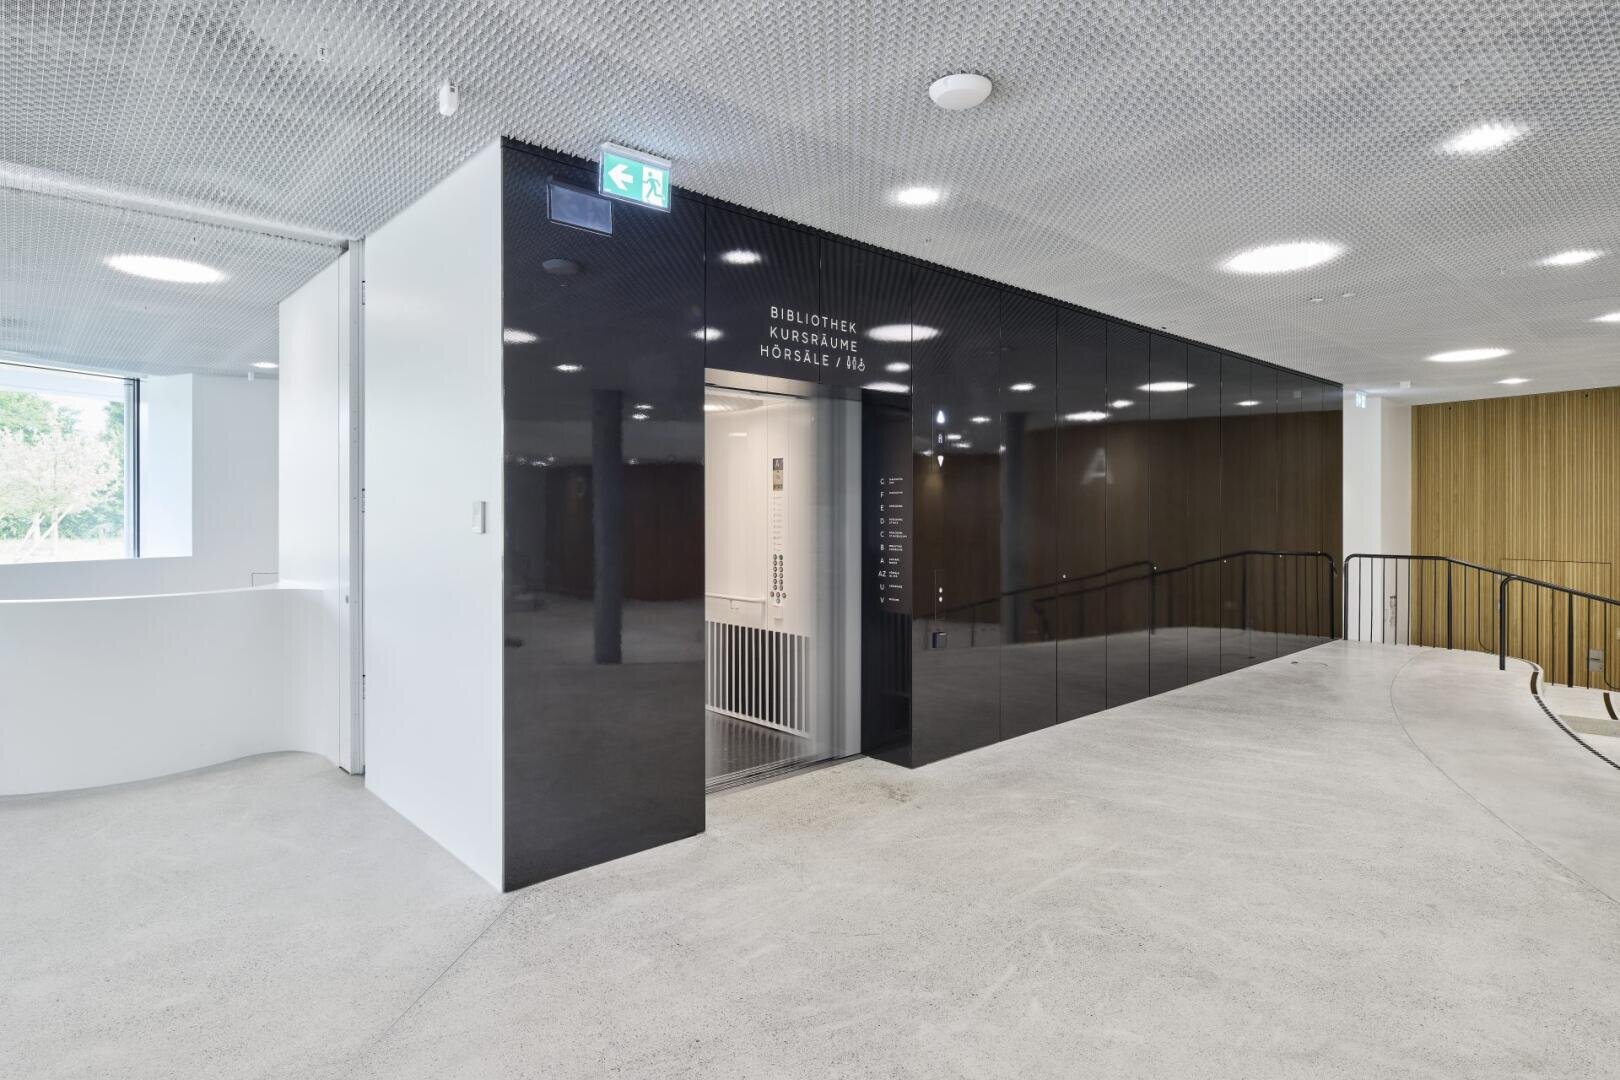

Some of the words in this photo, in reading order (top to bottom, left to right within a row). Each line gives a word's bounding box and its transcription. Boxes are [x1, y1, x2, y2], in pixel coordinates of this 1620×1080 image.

[770, 306, 857, 334] BIBLIOTHEK
[769, 326, 858, 353] KURSRÄUME
[760, 344, 830, 366] HÖRSÄLE
